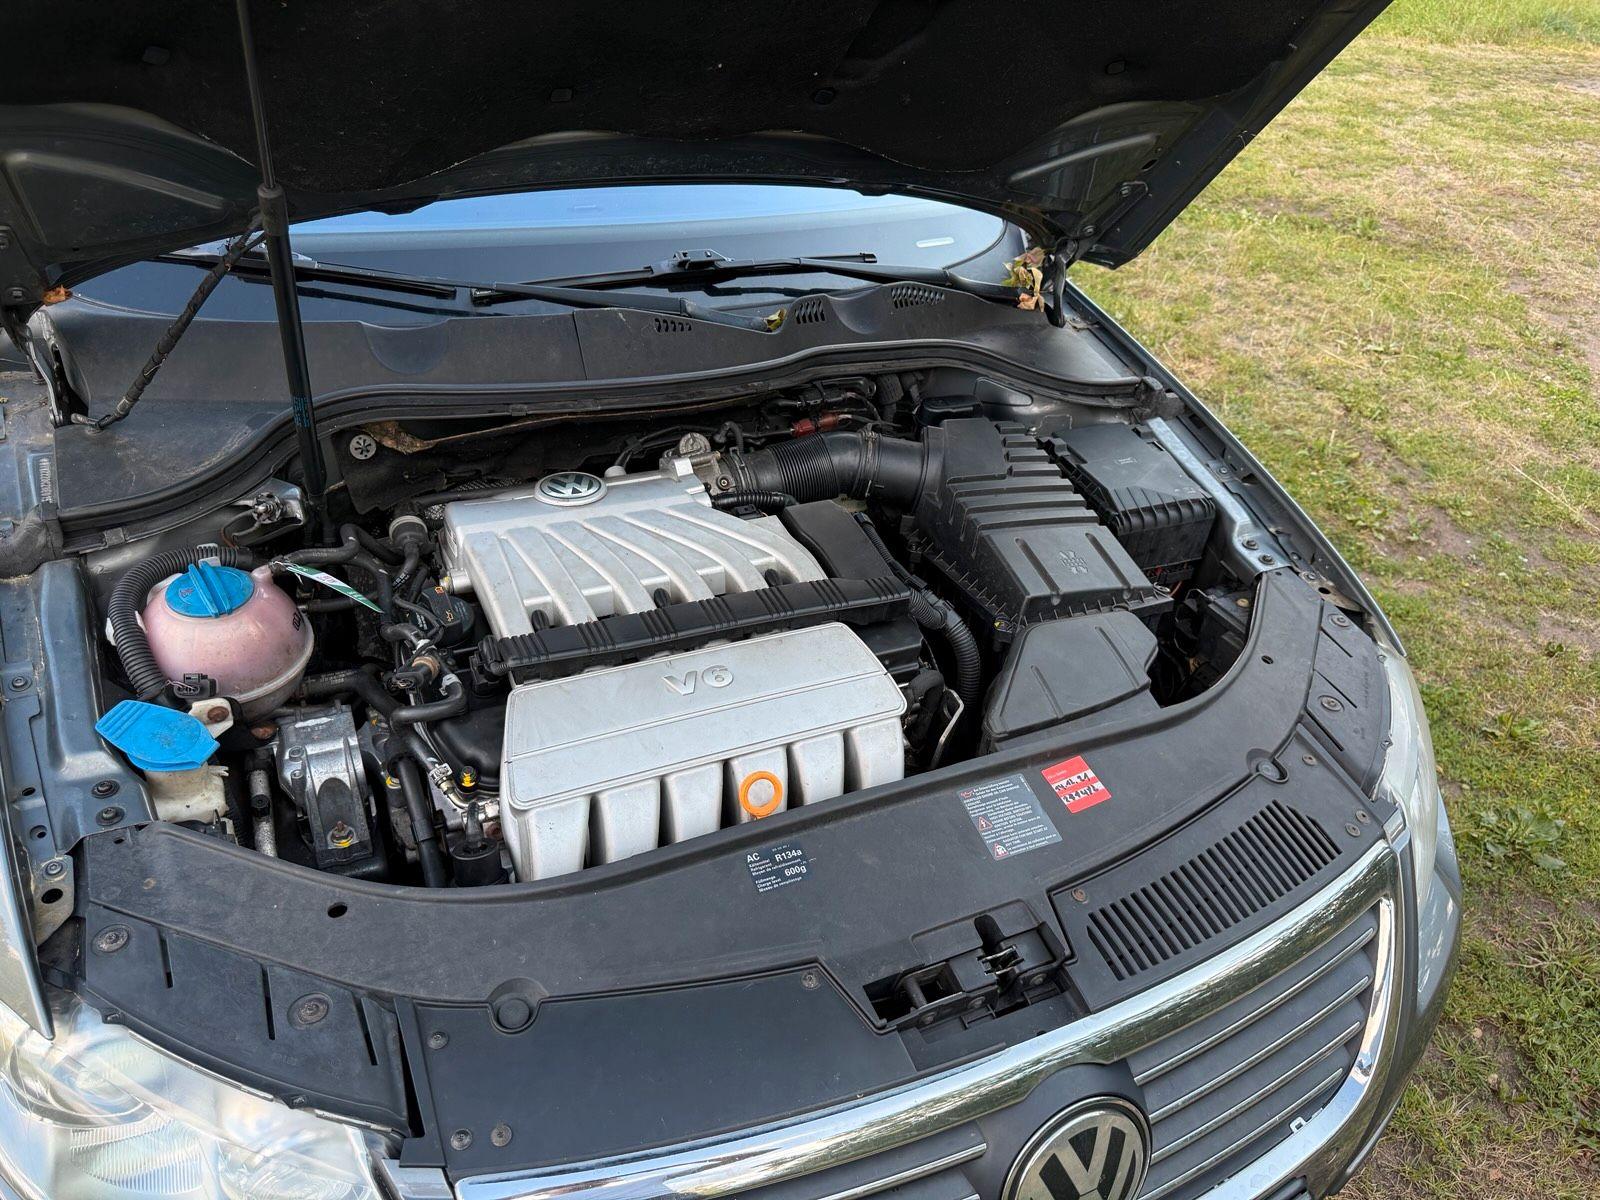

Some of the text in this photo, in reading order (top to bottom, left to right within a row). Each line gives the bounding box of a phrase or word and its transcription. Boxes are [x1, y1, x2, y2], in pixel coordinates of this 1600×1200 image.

[539, 472, 602, 500] VW
[662, 664, 735, 696] V6
[746, 852, 760, 863] AC
[774, 849, 803, 862] R134a
[784, 865, 807, 877] 600g
